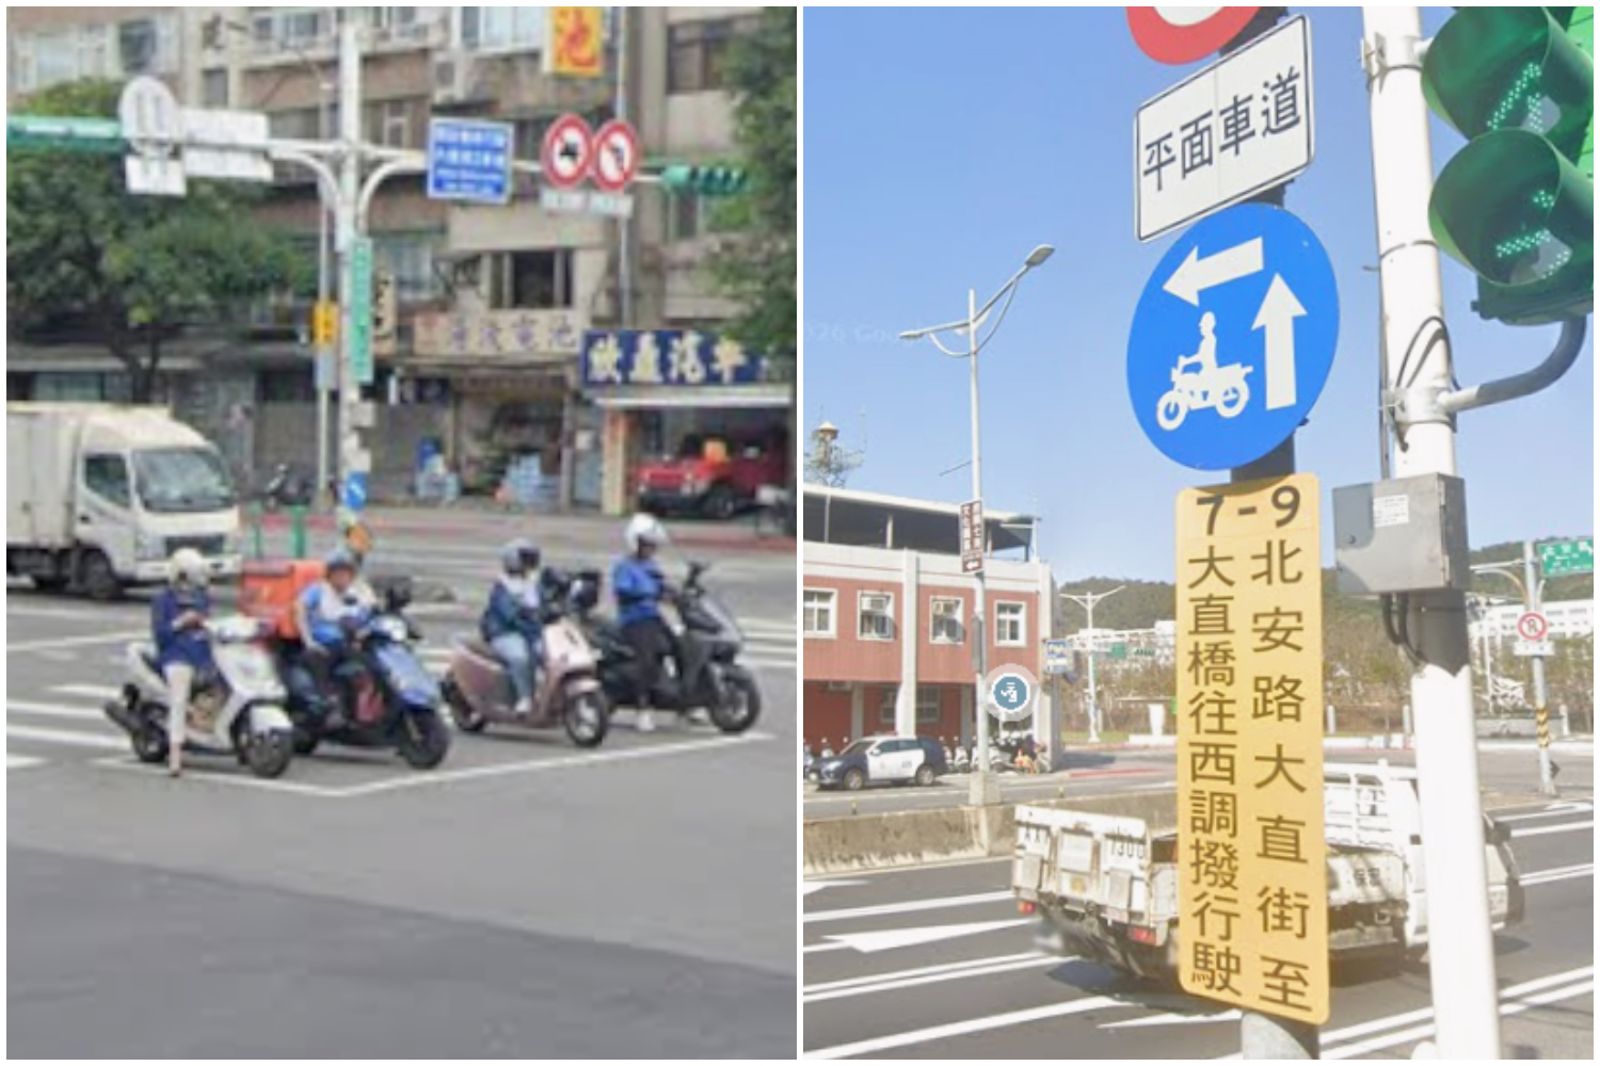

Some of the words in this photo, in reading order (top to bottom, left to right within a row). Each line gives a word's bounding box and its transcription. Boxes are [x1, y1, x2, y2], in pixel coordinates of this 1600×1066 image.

[1143, 66, 1301, 191] 平面車道
[1197, 485, 1300, 535] 7-9
[1187, 545, 1242, 996] 大直橋往西調撥行駛
[1250, 539, 1312, 1012] 北安路大直街至
